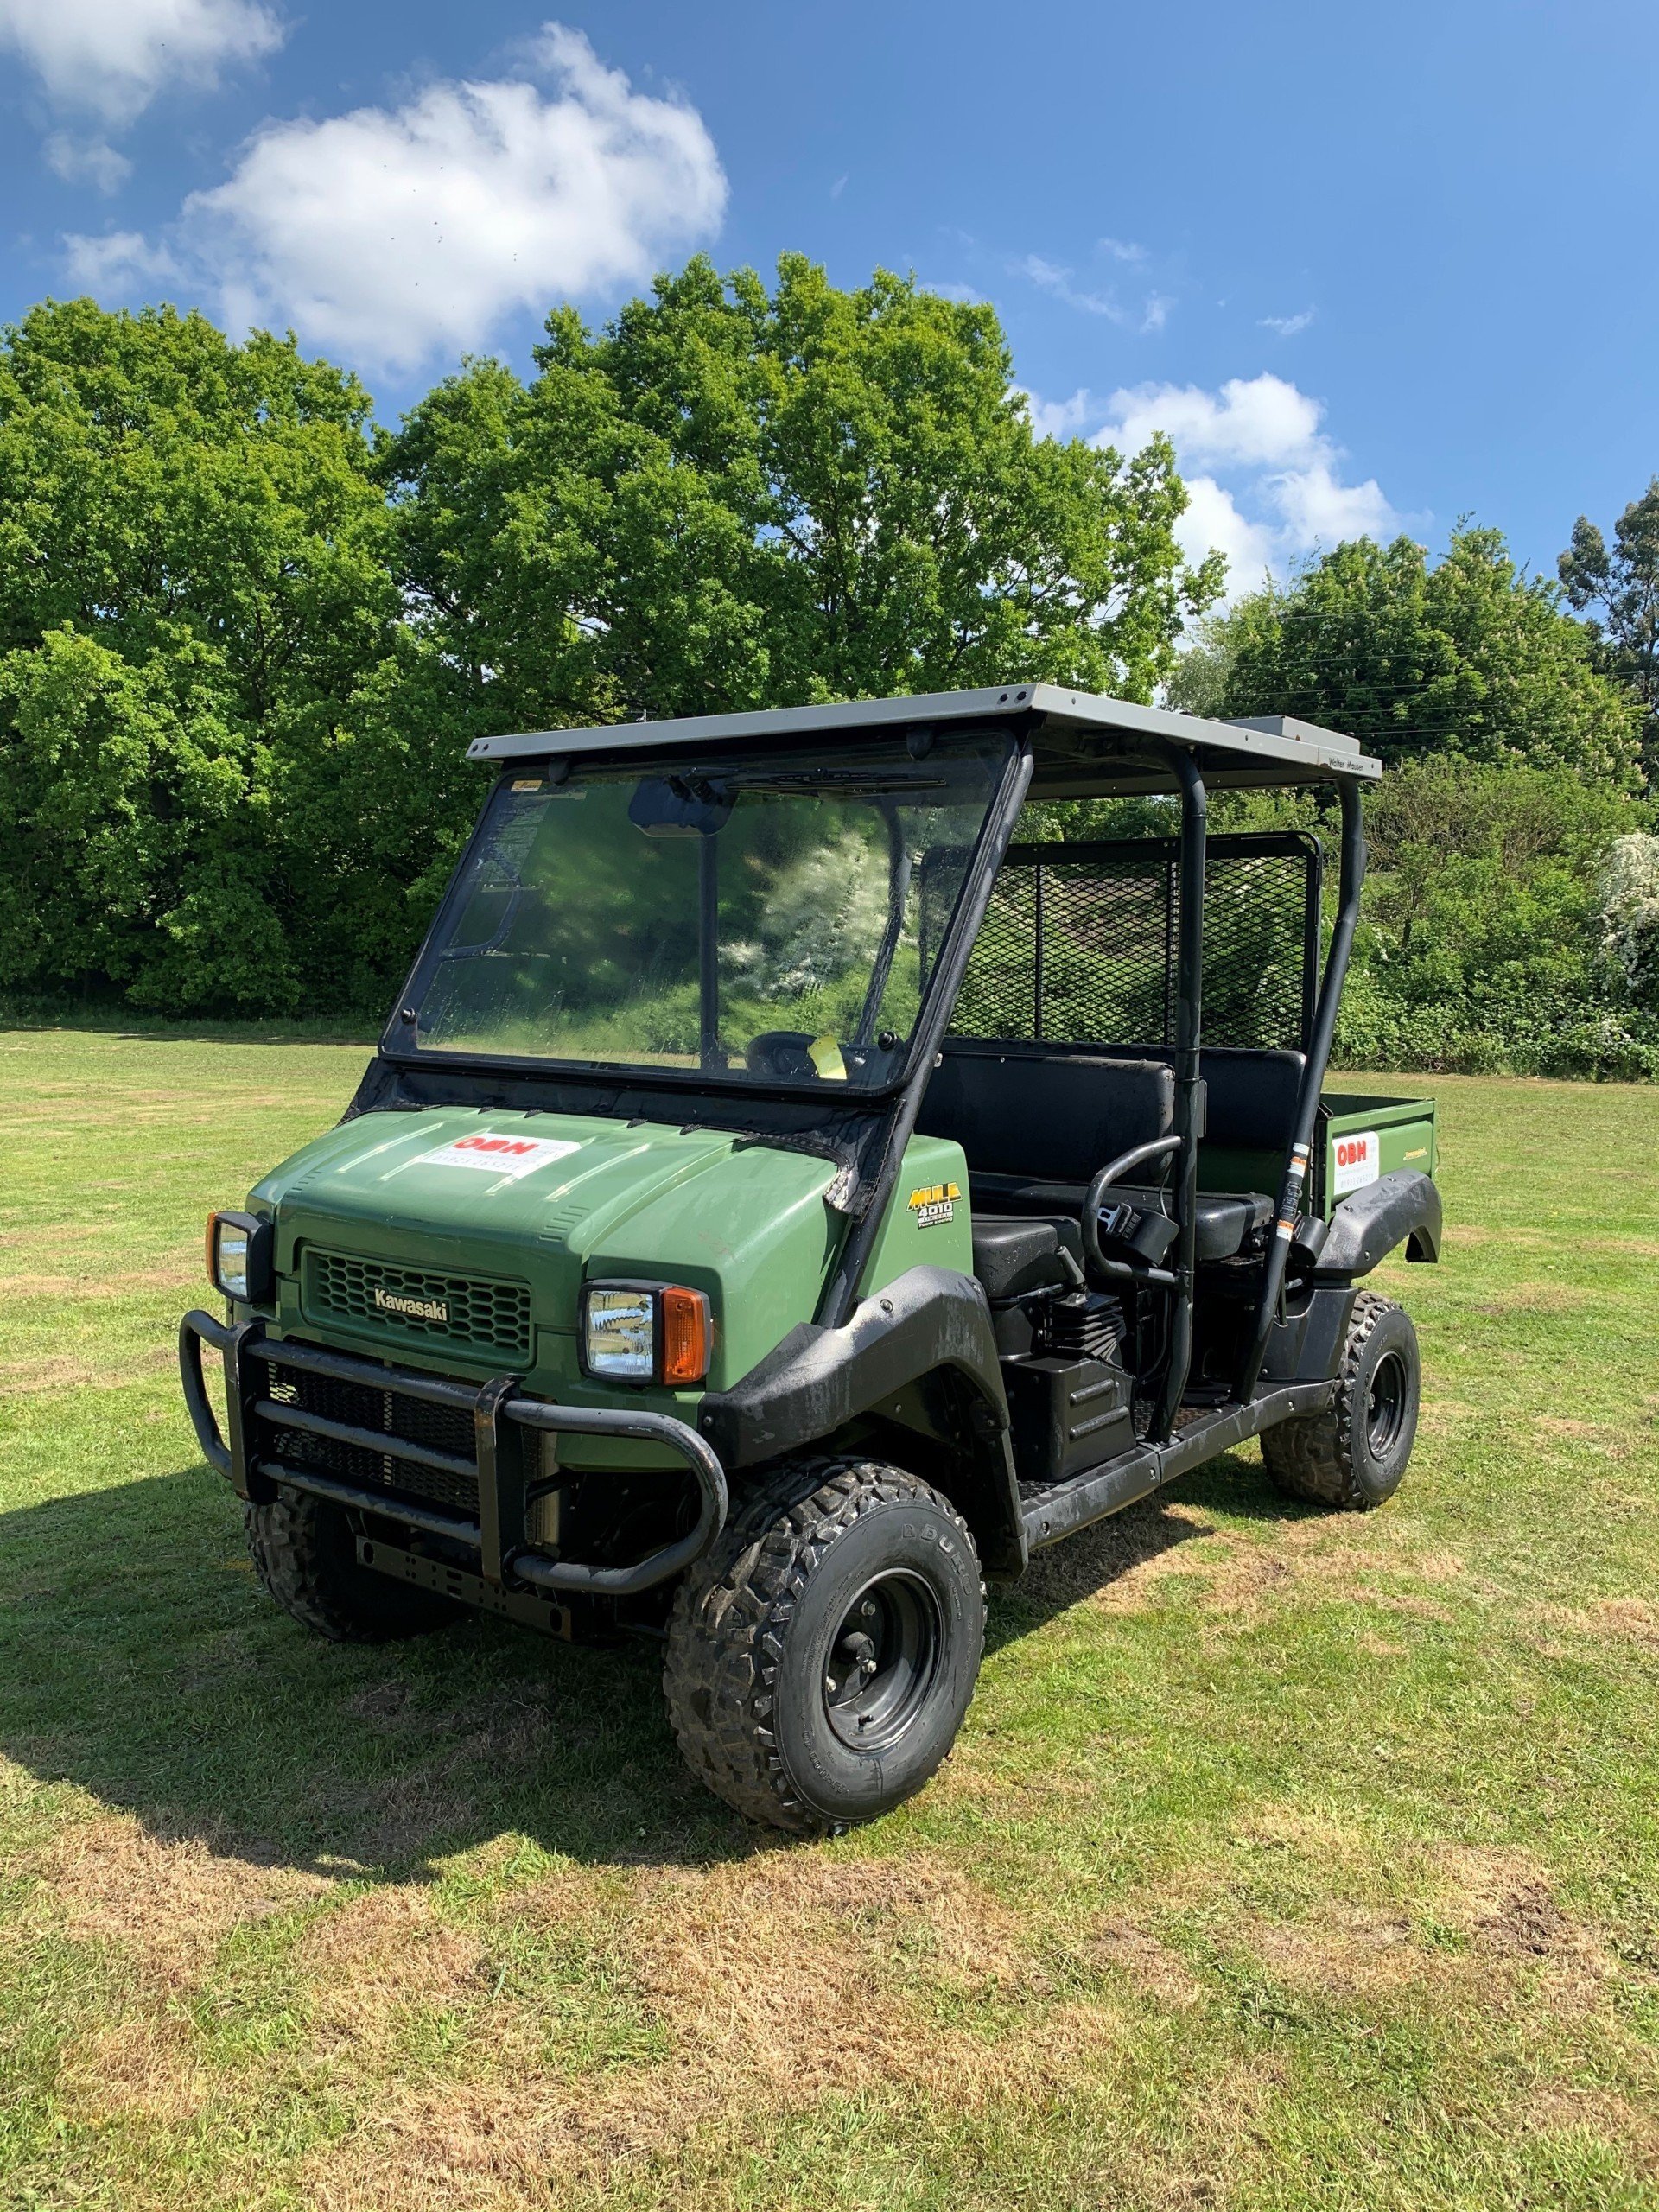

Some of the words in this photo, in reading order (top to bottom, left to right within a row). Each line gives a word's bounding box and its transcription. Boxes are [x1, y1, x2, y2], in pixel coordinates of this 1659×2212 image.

[1328, 757, 1345, 768] Walter
[453, 1137, 540, 1155] OBH
[1337, 1140, 1367, 1167] OBH
[906, 1181, 963, 1211] MULE
[918, 1202, 953, 1217] 4010
[375, 1288, 448, 1321] Kawasaki
